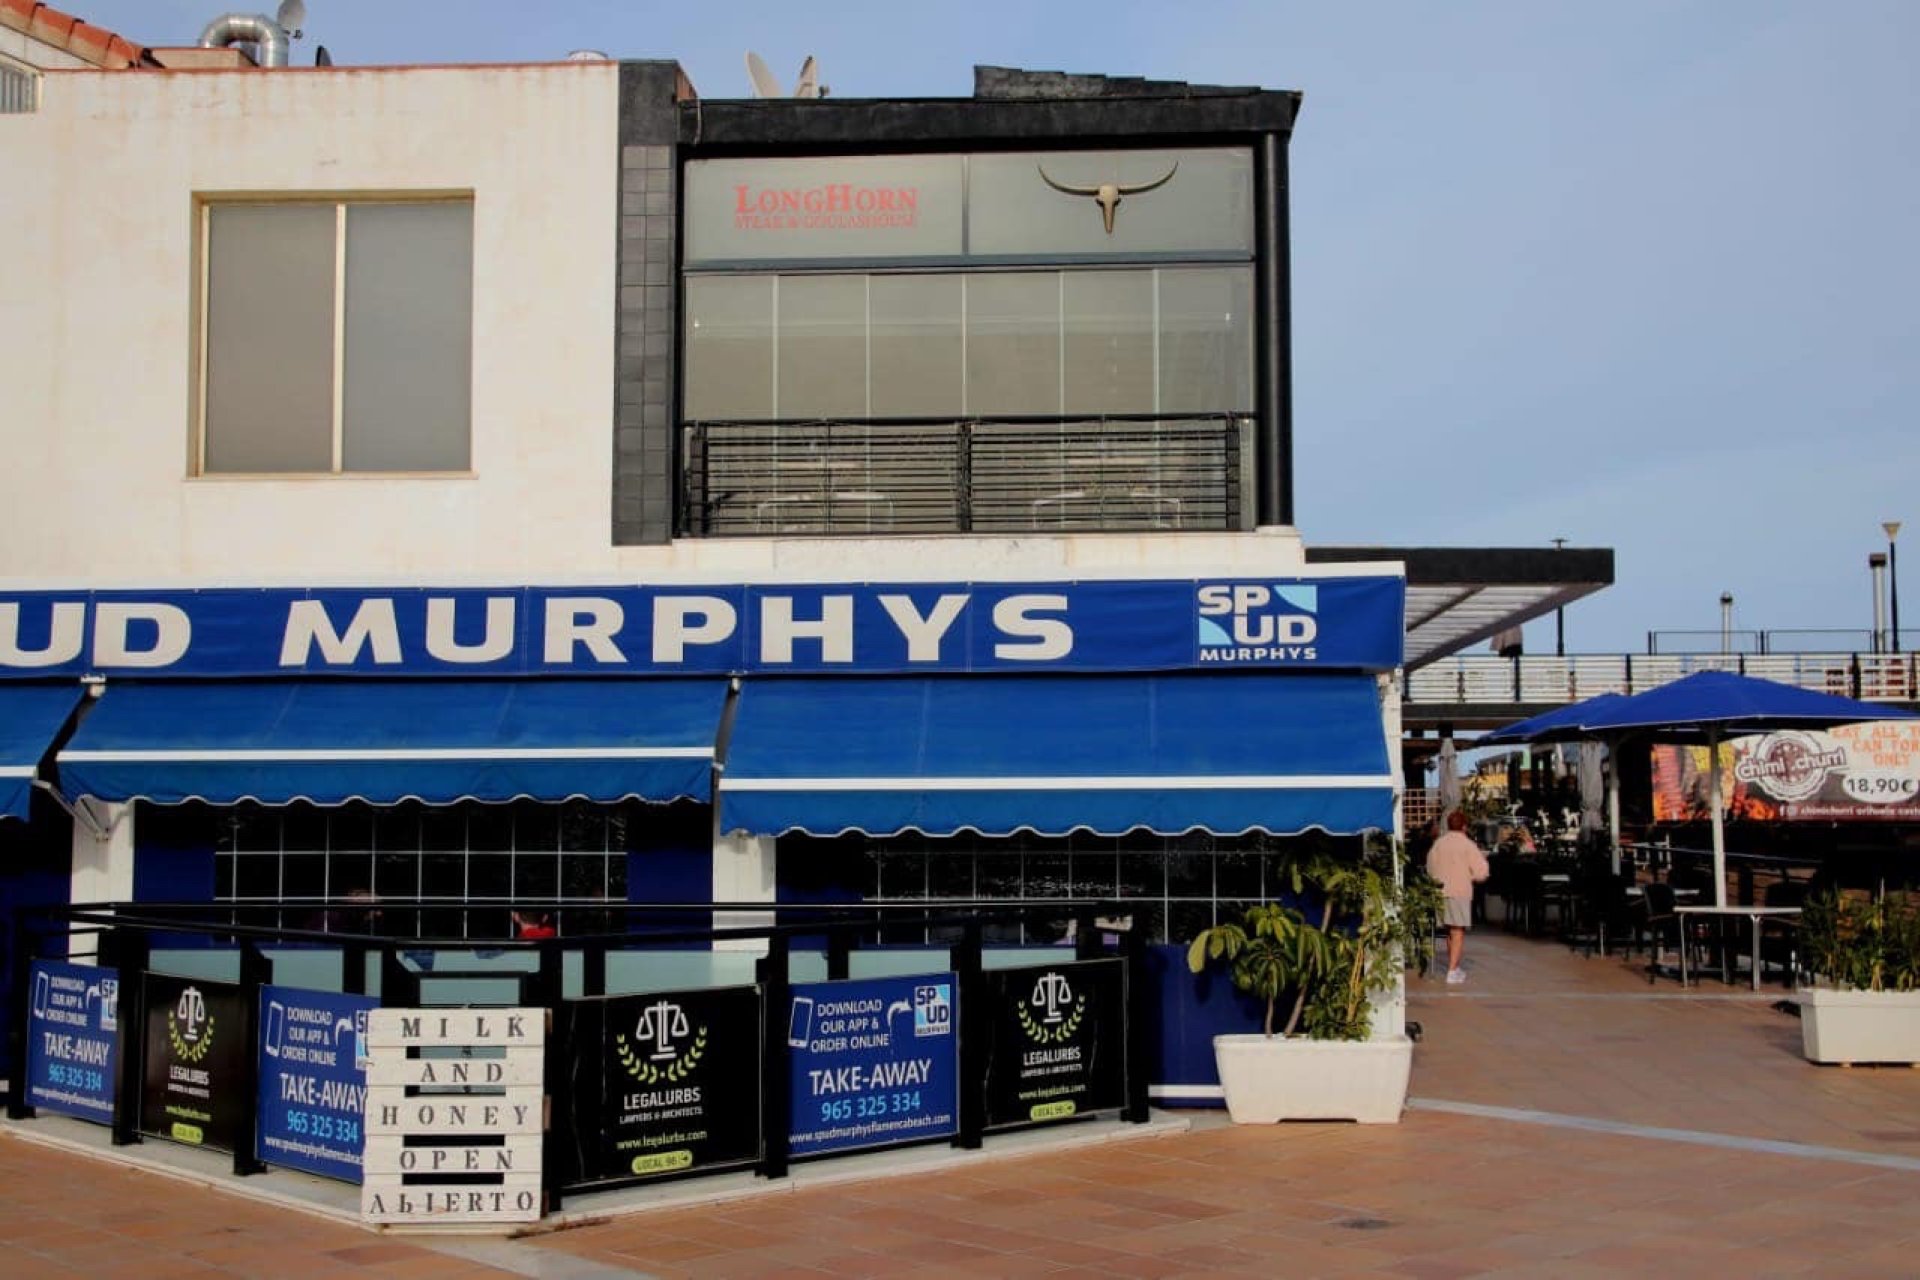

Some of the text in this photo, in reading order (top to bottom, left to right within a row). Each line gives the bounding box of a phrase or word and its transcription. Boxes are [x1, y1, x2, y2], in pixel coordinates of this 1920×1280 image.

[279, 593, 1074, 667] MURPHYS
[1200, 647, 1317, 661] MURPHYS
[1873, 753, 1910, 766] ONLY
[1848, 778, 1914, 795] 18,90€
[287, 1007, 333, 1025] DOWNLOAD
[817, 999, 882, 1017] DOWNLOAD
[401, 1016, 525, 1038] MILK
[820, 1017, 879, 1035] OUR APP &
[308, 1030, 323, 1044] APP
[811, 1033, 890, 1053] ORDER ONLINE
[44, 1032, 110, 1067] TAKE-AWAY
[281, 1045, 307, 1062] ORDER
[308, 1048, 337, 1067] ONLINE
[1022, 1046, 1081, 1066] LEGALURBS
[48, 1064, 64, 1084] 965
[67, 1068, 83, 1088] 325
[420, 1063, 503, 1083] AND
[809, 1058, 932, 1095] TAKE-AWAY
[279, 1073, 368, 1114] TAKE-AWAY
[623, 1086, 701, 1110] LEGALURBS
[382, 1105, 528, 1126] HONEY
[821, 1090, 921, 1122] 965 325 334
[287, 1109, 359, 1144] 965 325 334
[400, 1150, 513, 1170] OPEN
